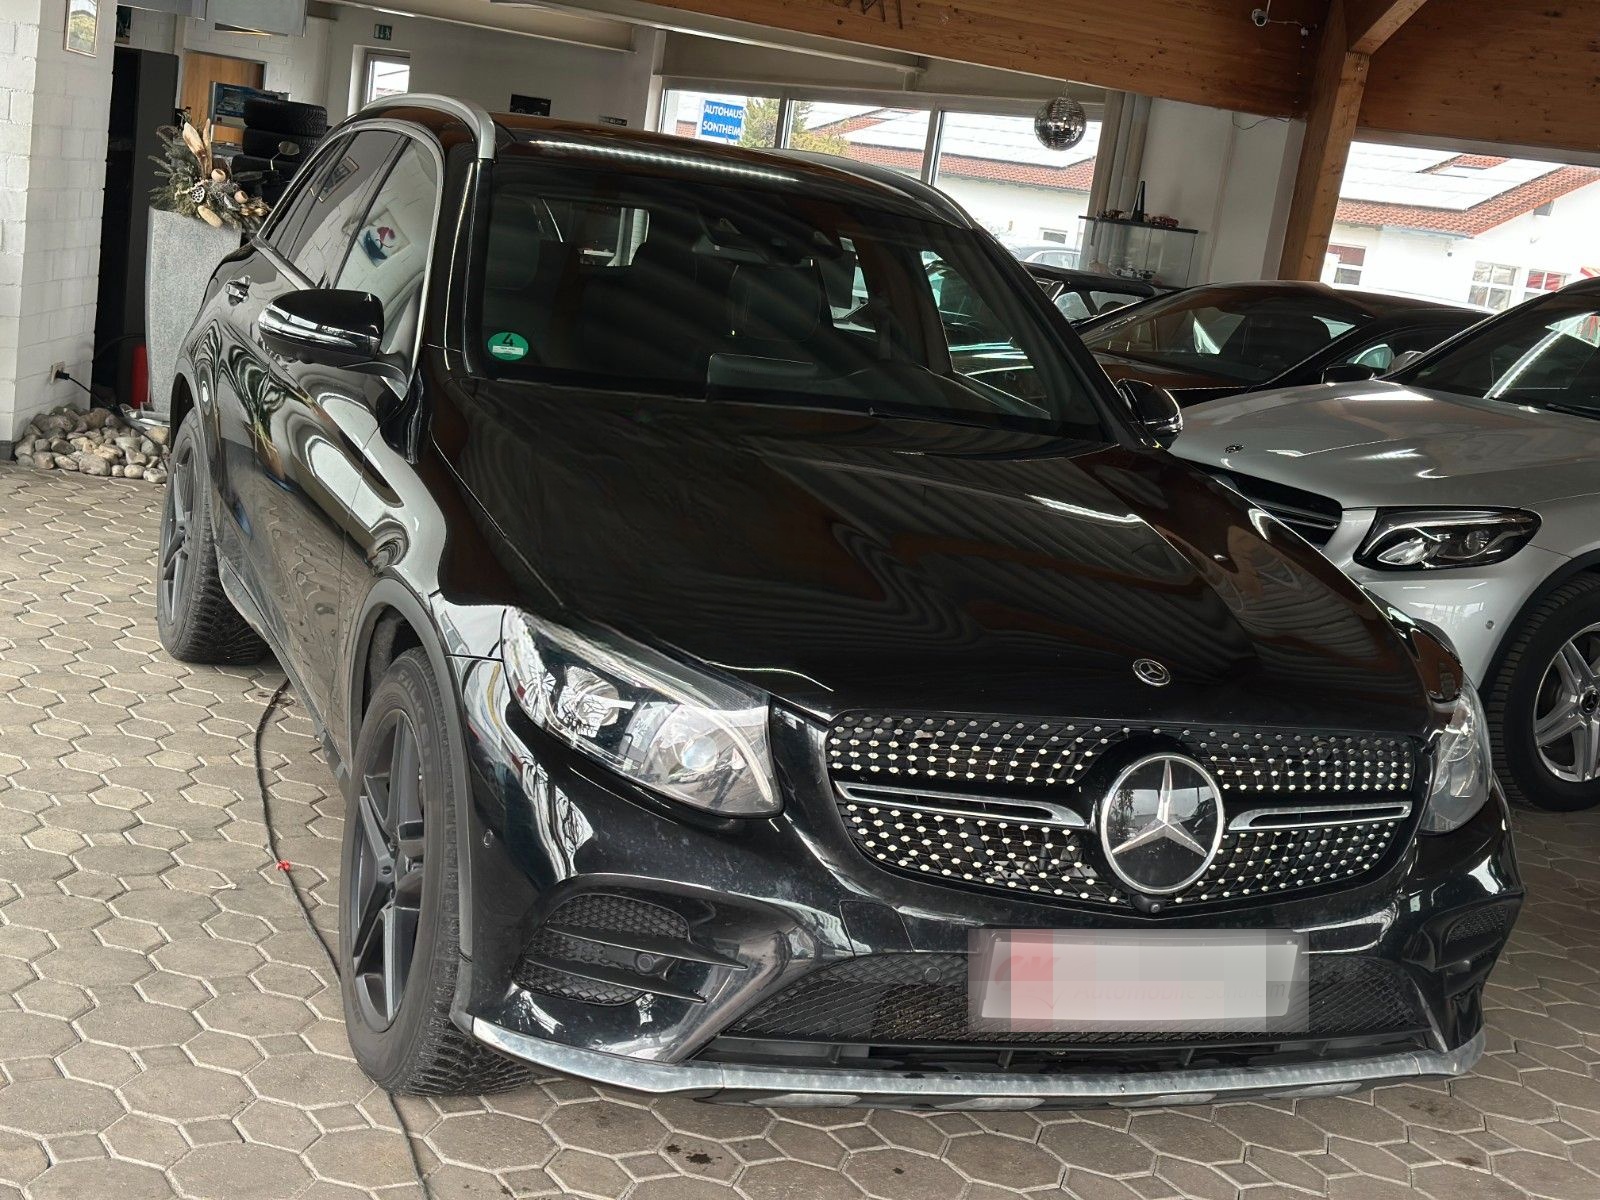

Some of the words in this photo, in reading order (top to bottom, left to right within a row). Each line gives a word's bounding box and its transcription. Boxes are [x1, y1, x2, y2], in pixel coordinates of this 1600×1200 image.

[704, 105, 743, 119] AUTOHAUS
[702, 121, 742, 136] SONTHEIM
[502, 333, 514, 346] 4
